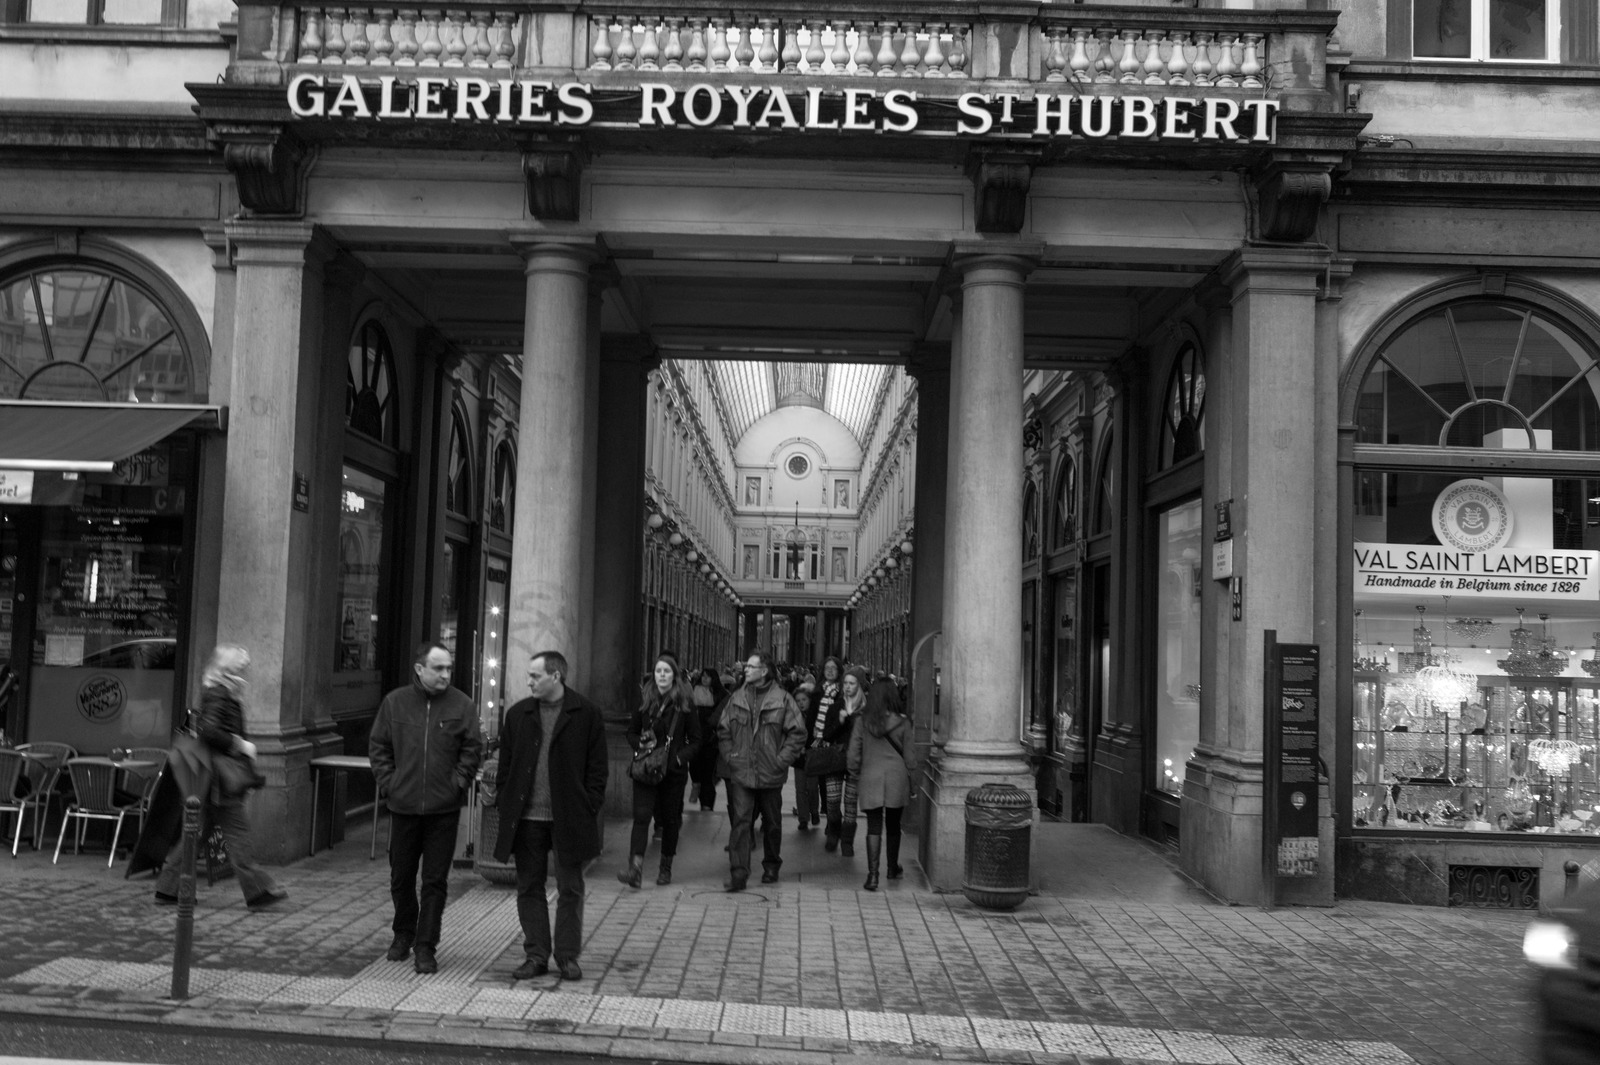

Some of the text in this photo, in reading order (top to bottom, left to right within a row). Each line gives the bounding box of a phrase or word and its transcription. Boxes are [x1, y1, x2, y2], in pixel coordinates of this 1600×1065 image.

[287, 73, 594, 126] GALERIES
[638, 82, 919, 133] ROYALES
[1032, 93, 1281, 142] HUBERT
[1450, 493, 1496, 511] VAL SAINT
[1453, 530, 1494, 545] LAMBERT
[1354, 548, 1593, 576] VAL SAINT LAMBERT
[1364, 574, 1581, 594] Handmade in Belgium since 1826
